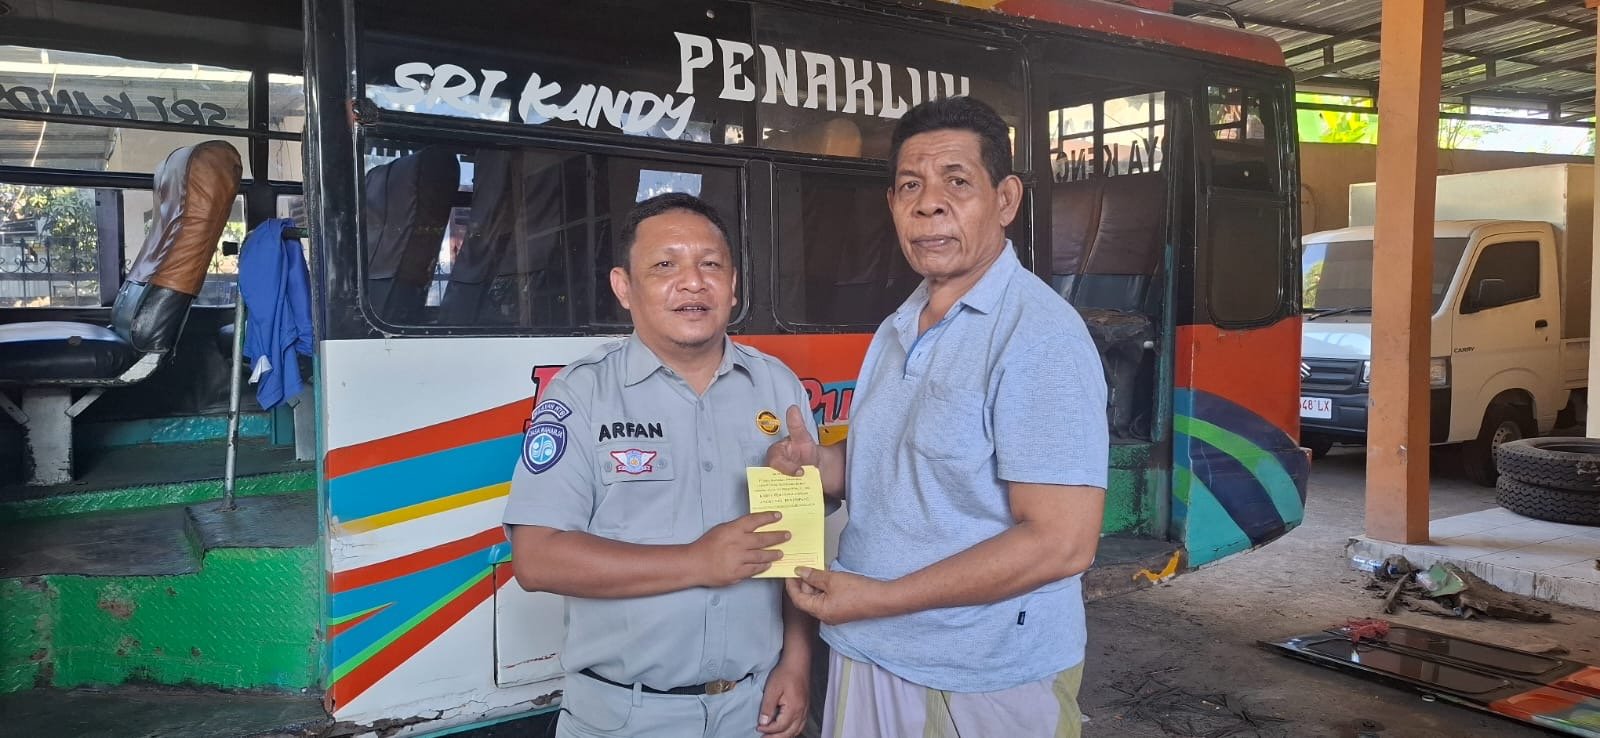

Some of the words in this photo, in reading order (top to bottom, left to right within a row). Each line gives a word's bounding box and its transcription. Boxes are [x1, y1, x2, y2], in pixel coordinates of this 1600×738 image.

[393, 62, 508, 108] SRI
[518, 72, 695, 139] KANDY
[1300, 399, 1313, 410] 48
[1318, 400, 1329, 411] LX
[599, 422, 663, 442] ARFAN
